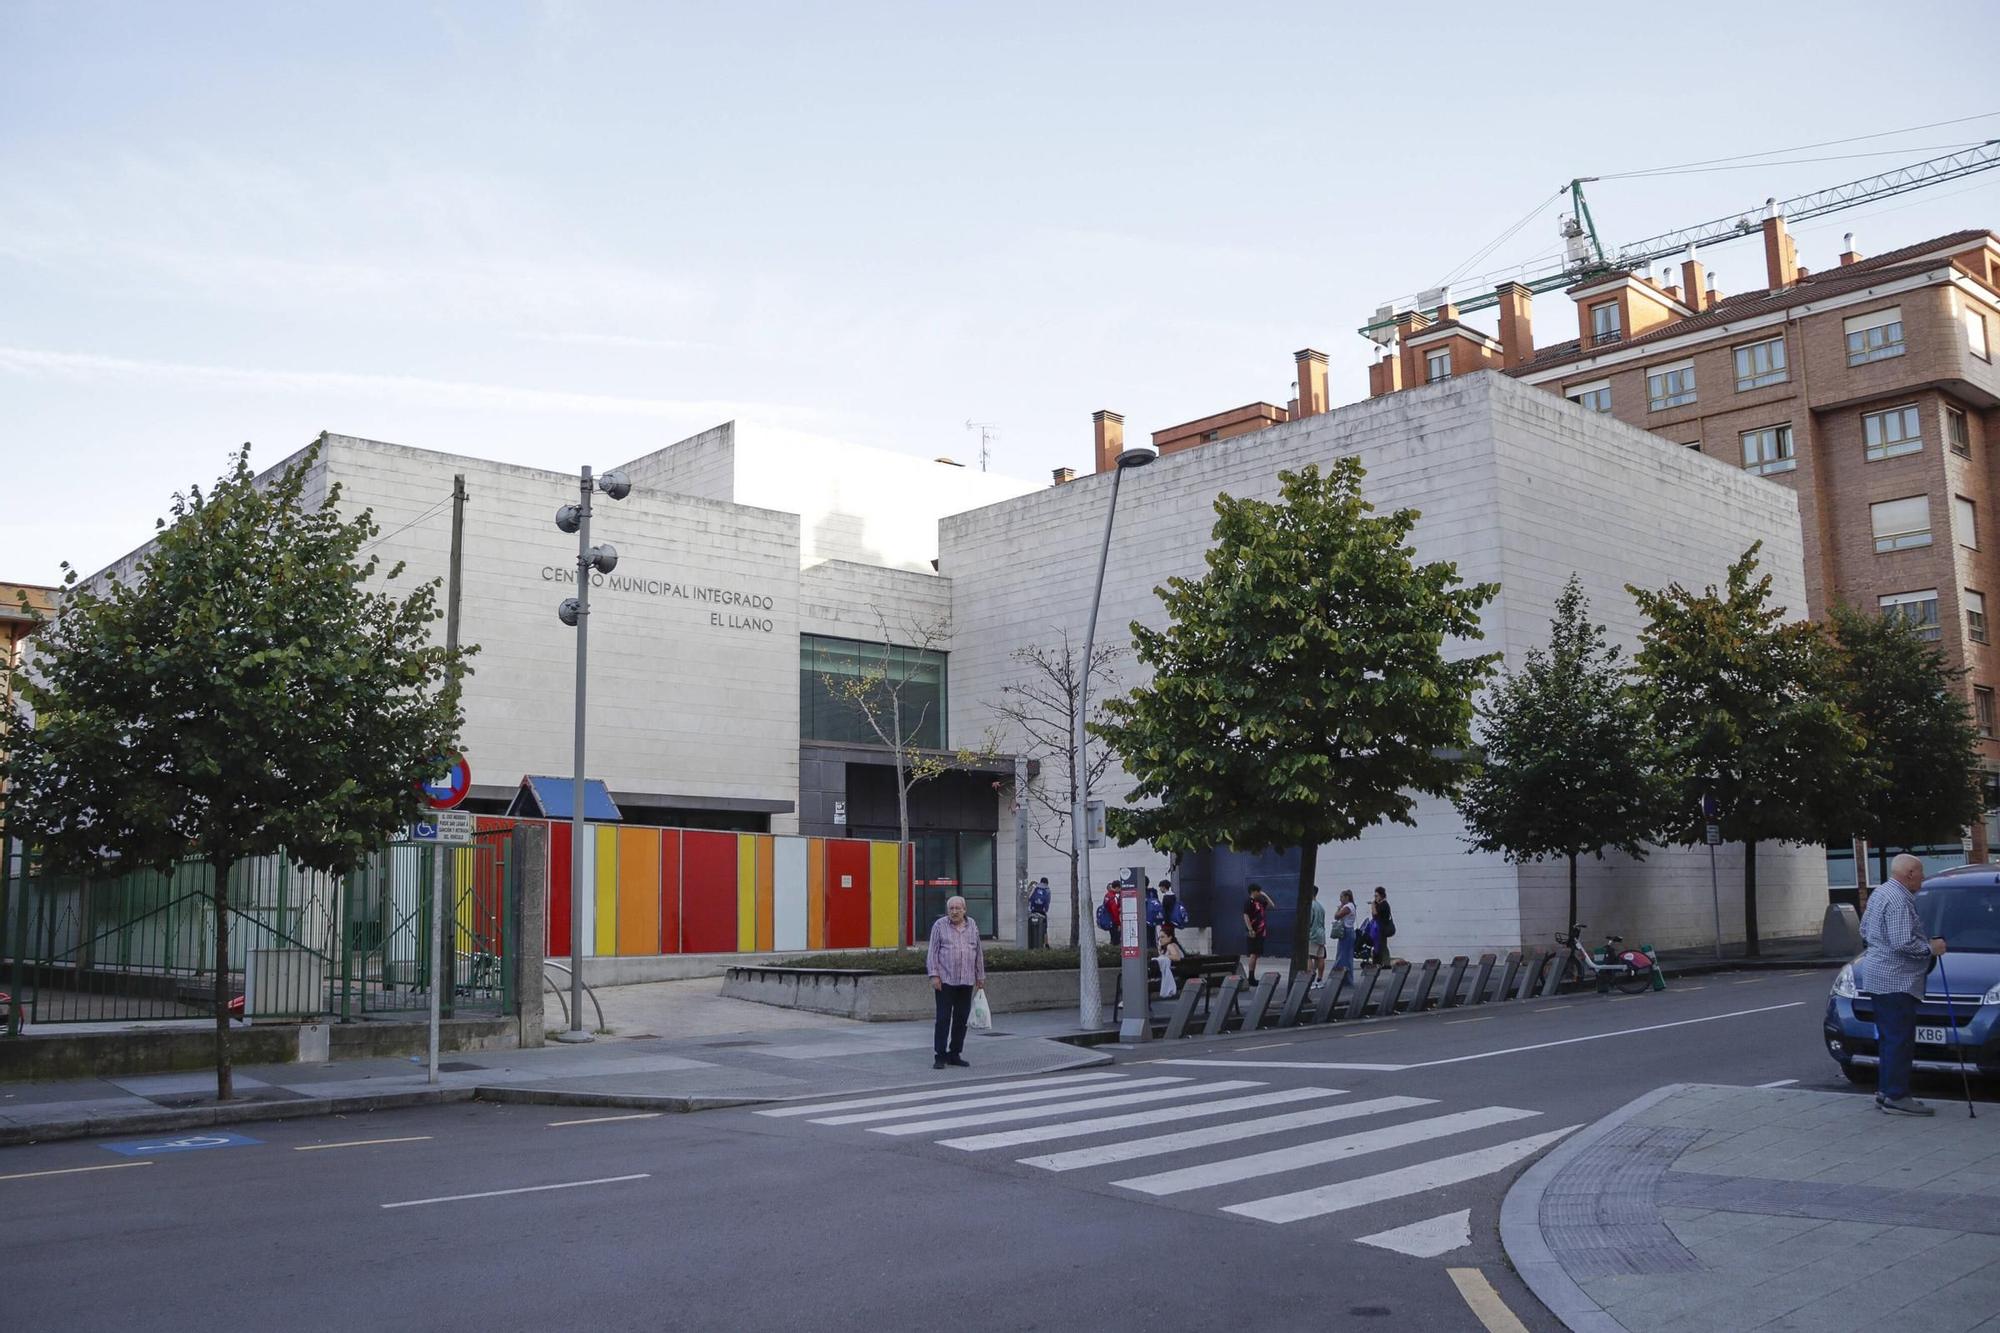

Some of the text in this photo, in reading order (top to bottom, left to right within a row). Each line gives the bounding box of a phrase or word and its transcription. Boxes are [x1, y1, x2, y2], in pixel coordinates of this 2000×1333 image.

[542, 566, 773, 610] CENO MUNICIPAL INTEGRADO
[711, 612, 773, 632] EL LLANO
[1918, 1028, 1943, 1041] KBG
